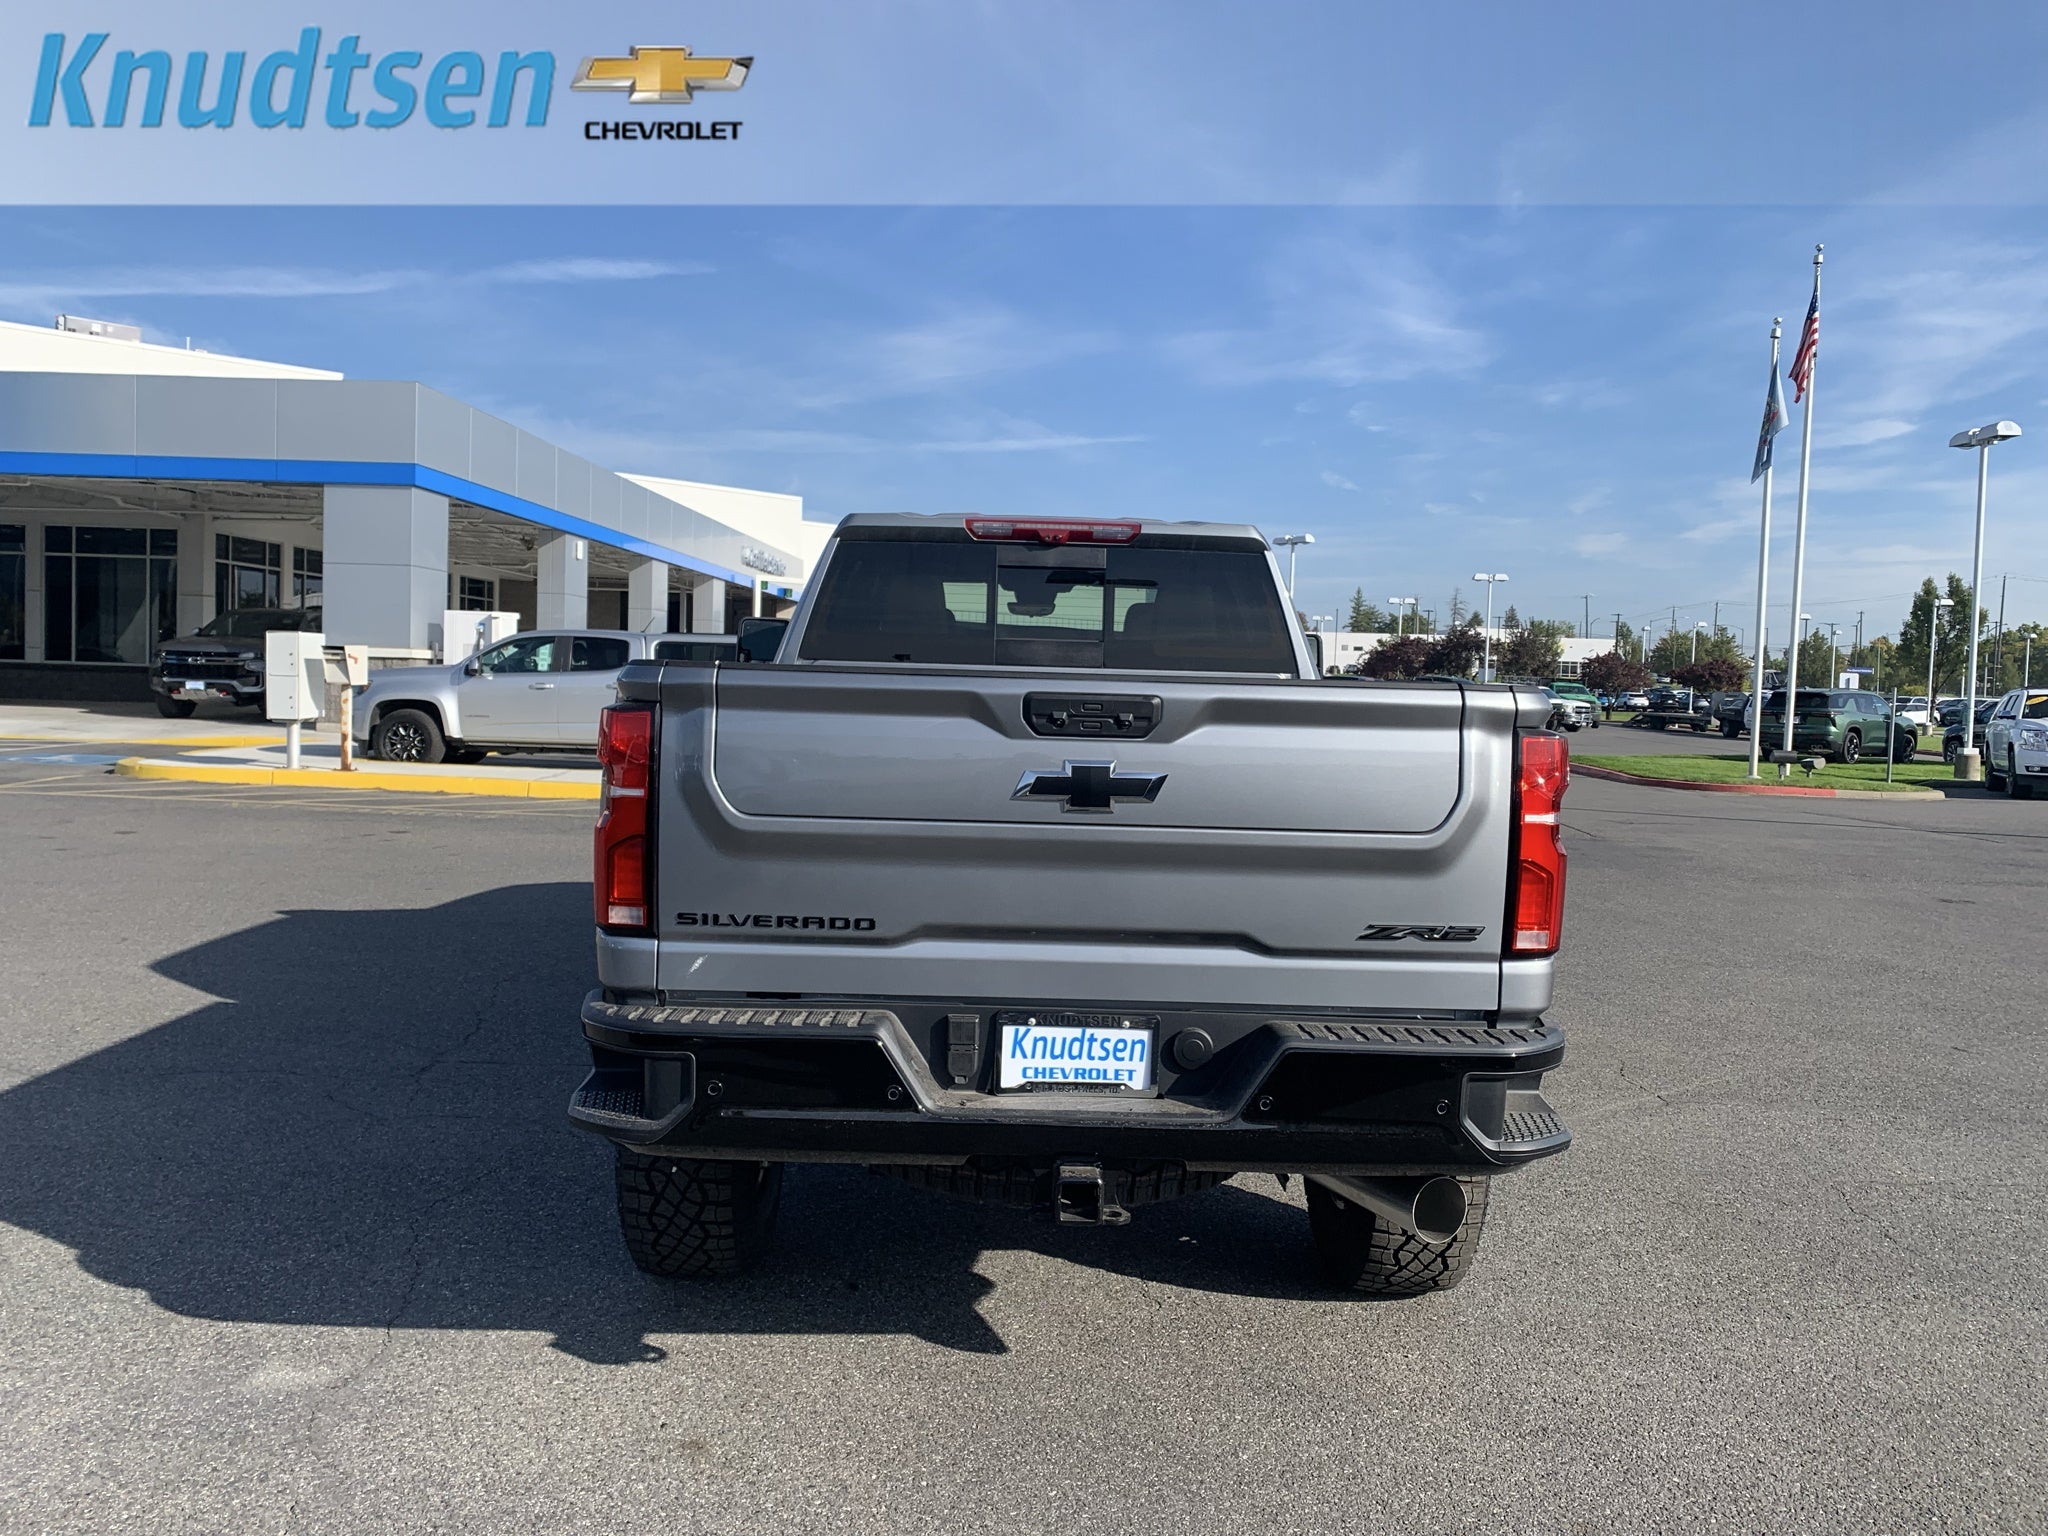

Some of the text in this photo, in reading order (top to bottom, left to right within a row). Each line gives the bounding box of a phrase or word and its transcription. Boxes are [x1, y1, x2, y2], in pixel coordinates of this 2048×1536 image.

[676, 912, 876, 931] SILVERADO
[1356, 924, 1486, 942] ZR2
[1036, 1014, 1121, 1027] KNUDTSEN
[1010, 1027, 1146, 1063] Knudtsen
[1021, 1066, 1137, 1082] CHEVROLET
